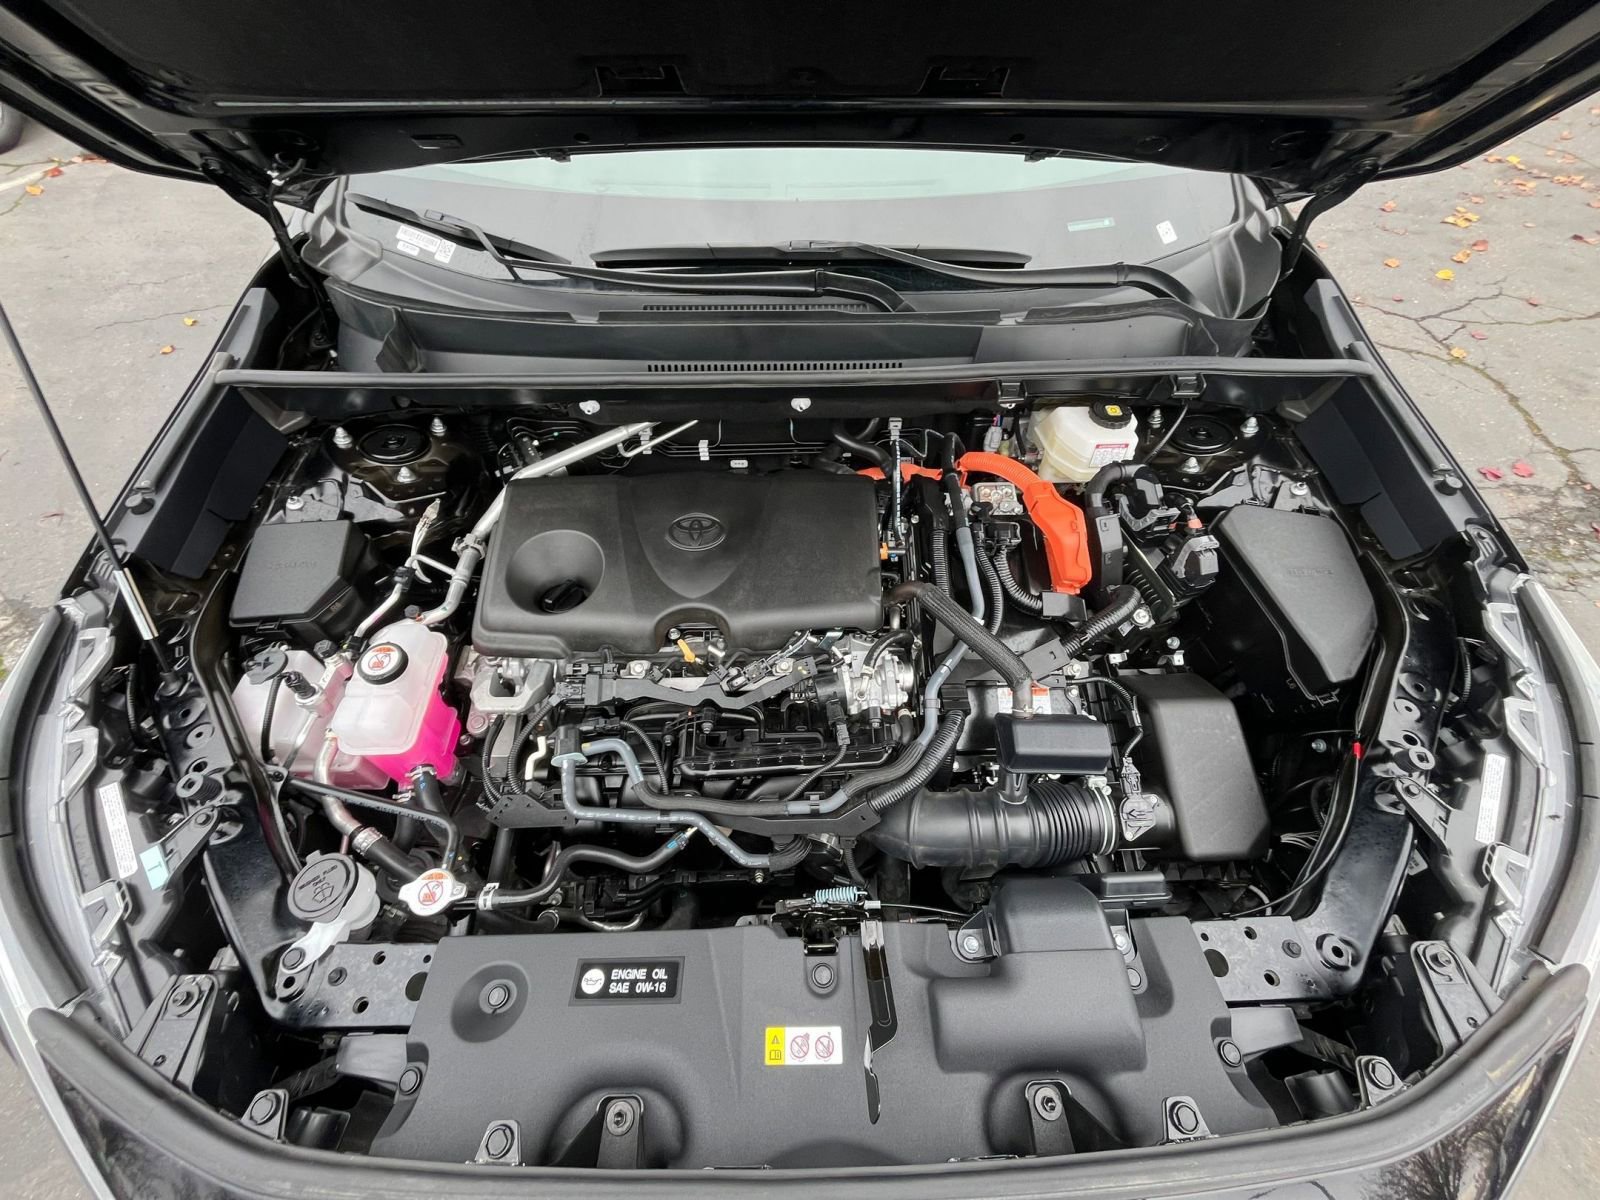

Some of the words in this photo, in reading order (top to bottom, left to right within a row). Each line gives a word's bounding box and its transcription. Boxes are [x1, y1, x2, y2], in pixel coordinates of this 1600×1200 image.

[611, 968, 648, 980] ENGINE
[651, 968, 668, 980] OIL
[608, 982, 630, 994] SAE
[635, 982, 667, 994] 0W-16
